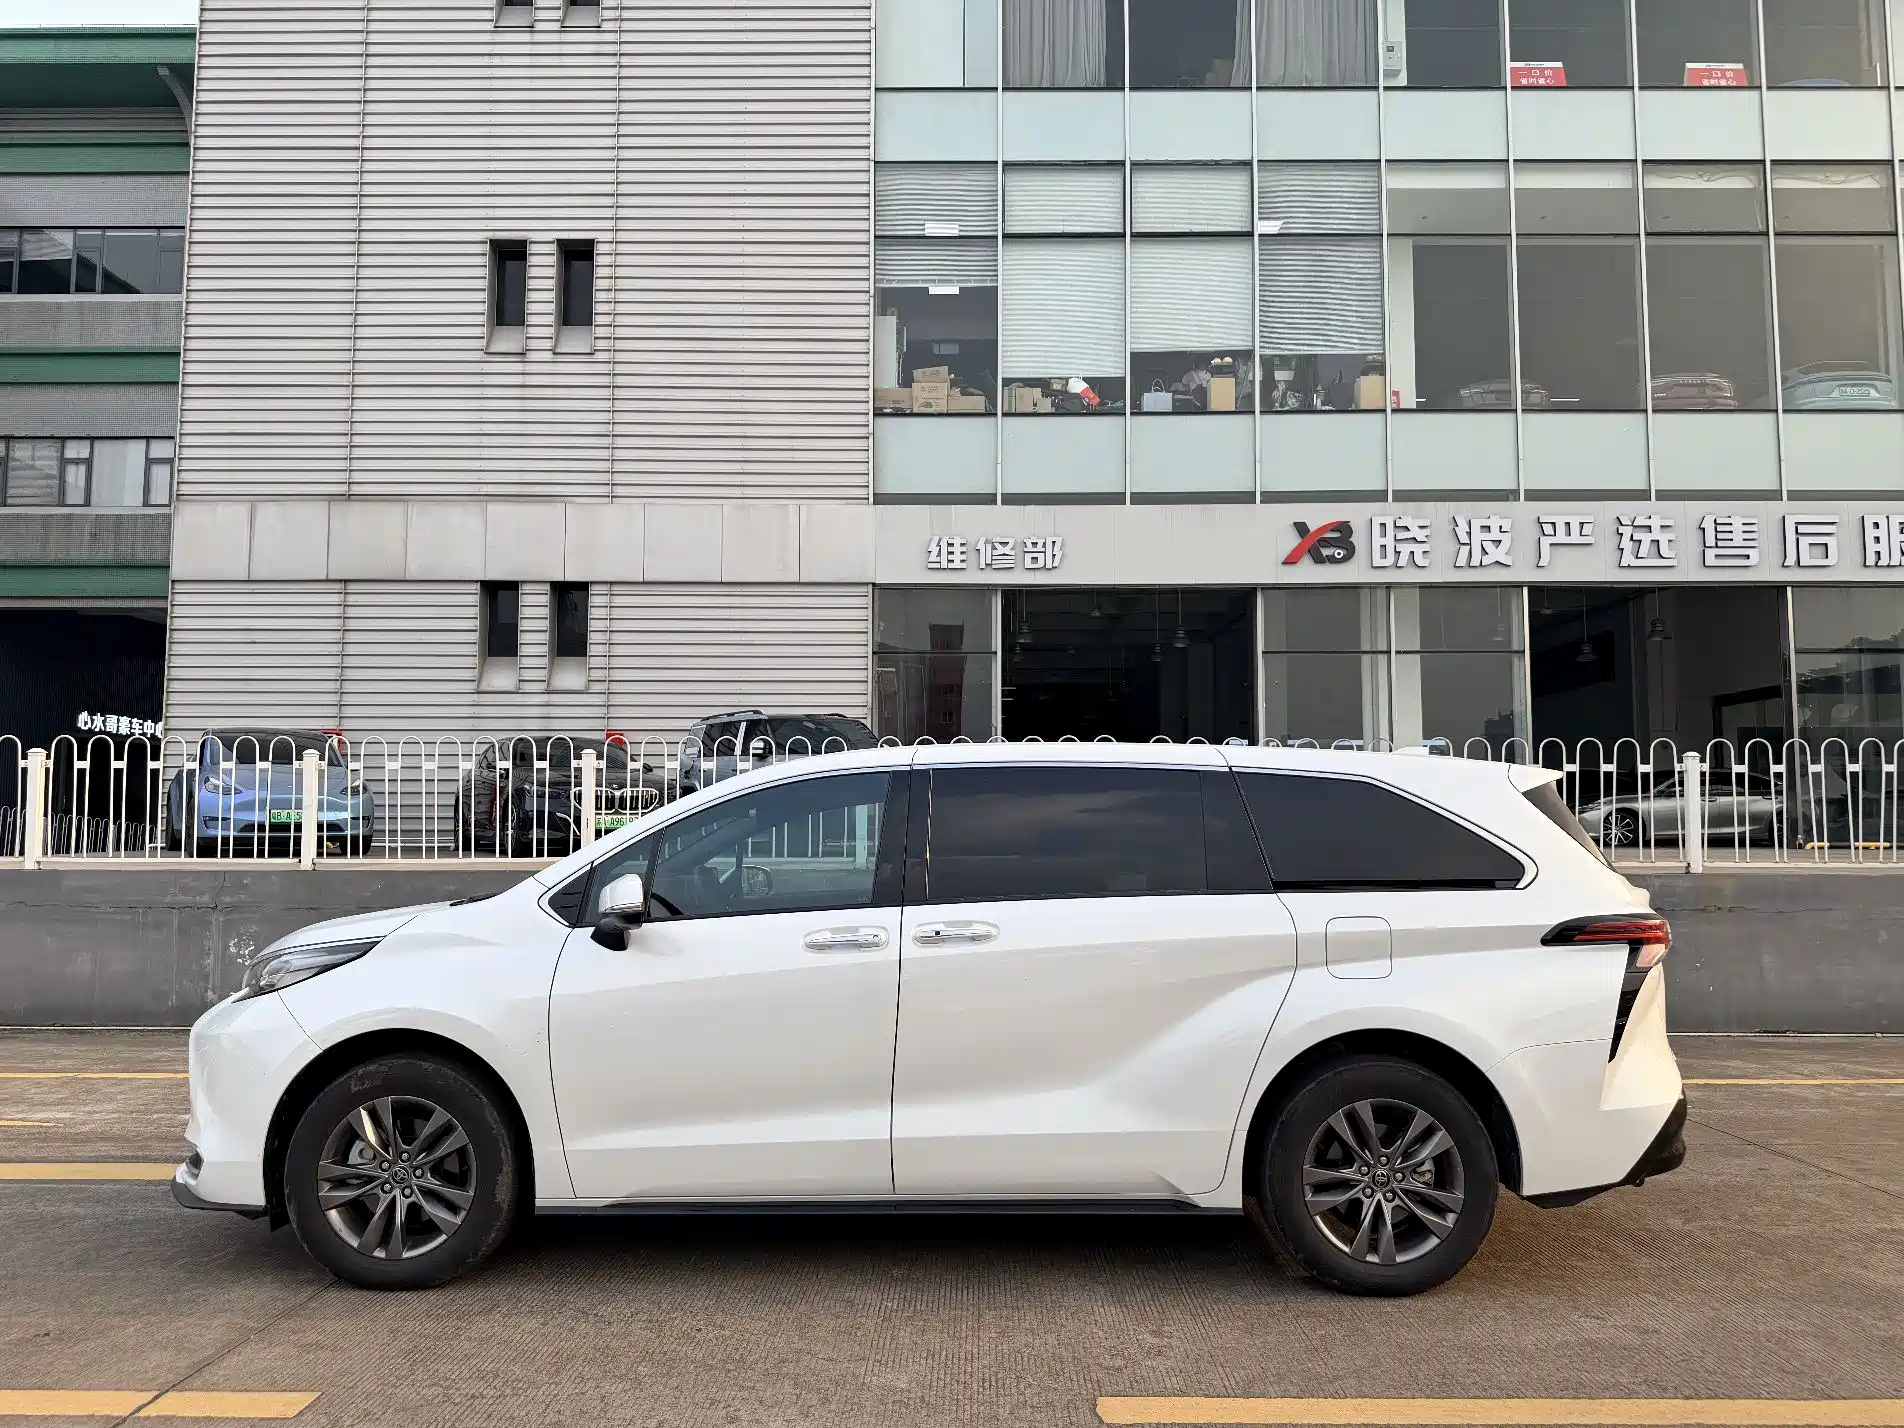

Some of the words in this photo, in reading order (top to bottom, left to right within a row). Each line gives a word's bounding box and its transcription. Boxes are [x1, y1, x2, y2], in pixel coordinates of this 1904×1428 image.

[926, 535, 1065, 571] 维修部
[1370, 513, 1904, 569] 晓波严选售后服
